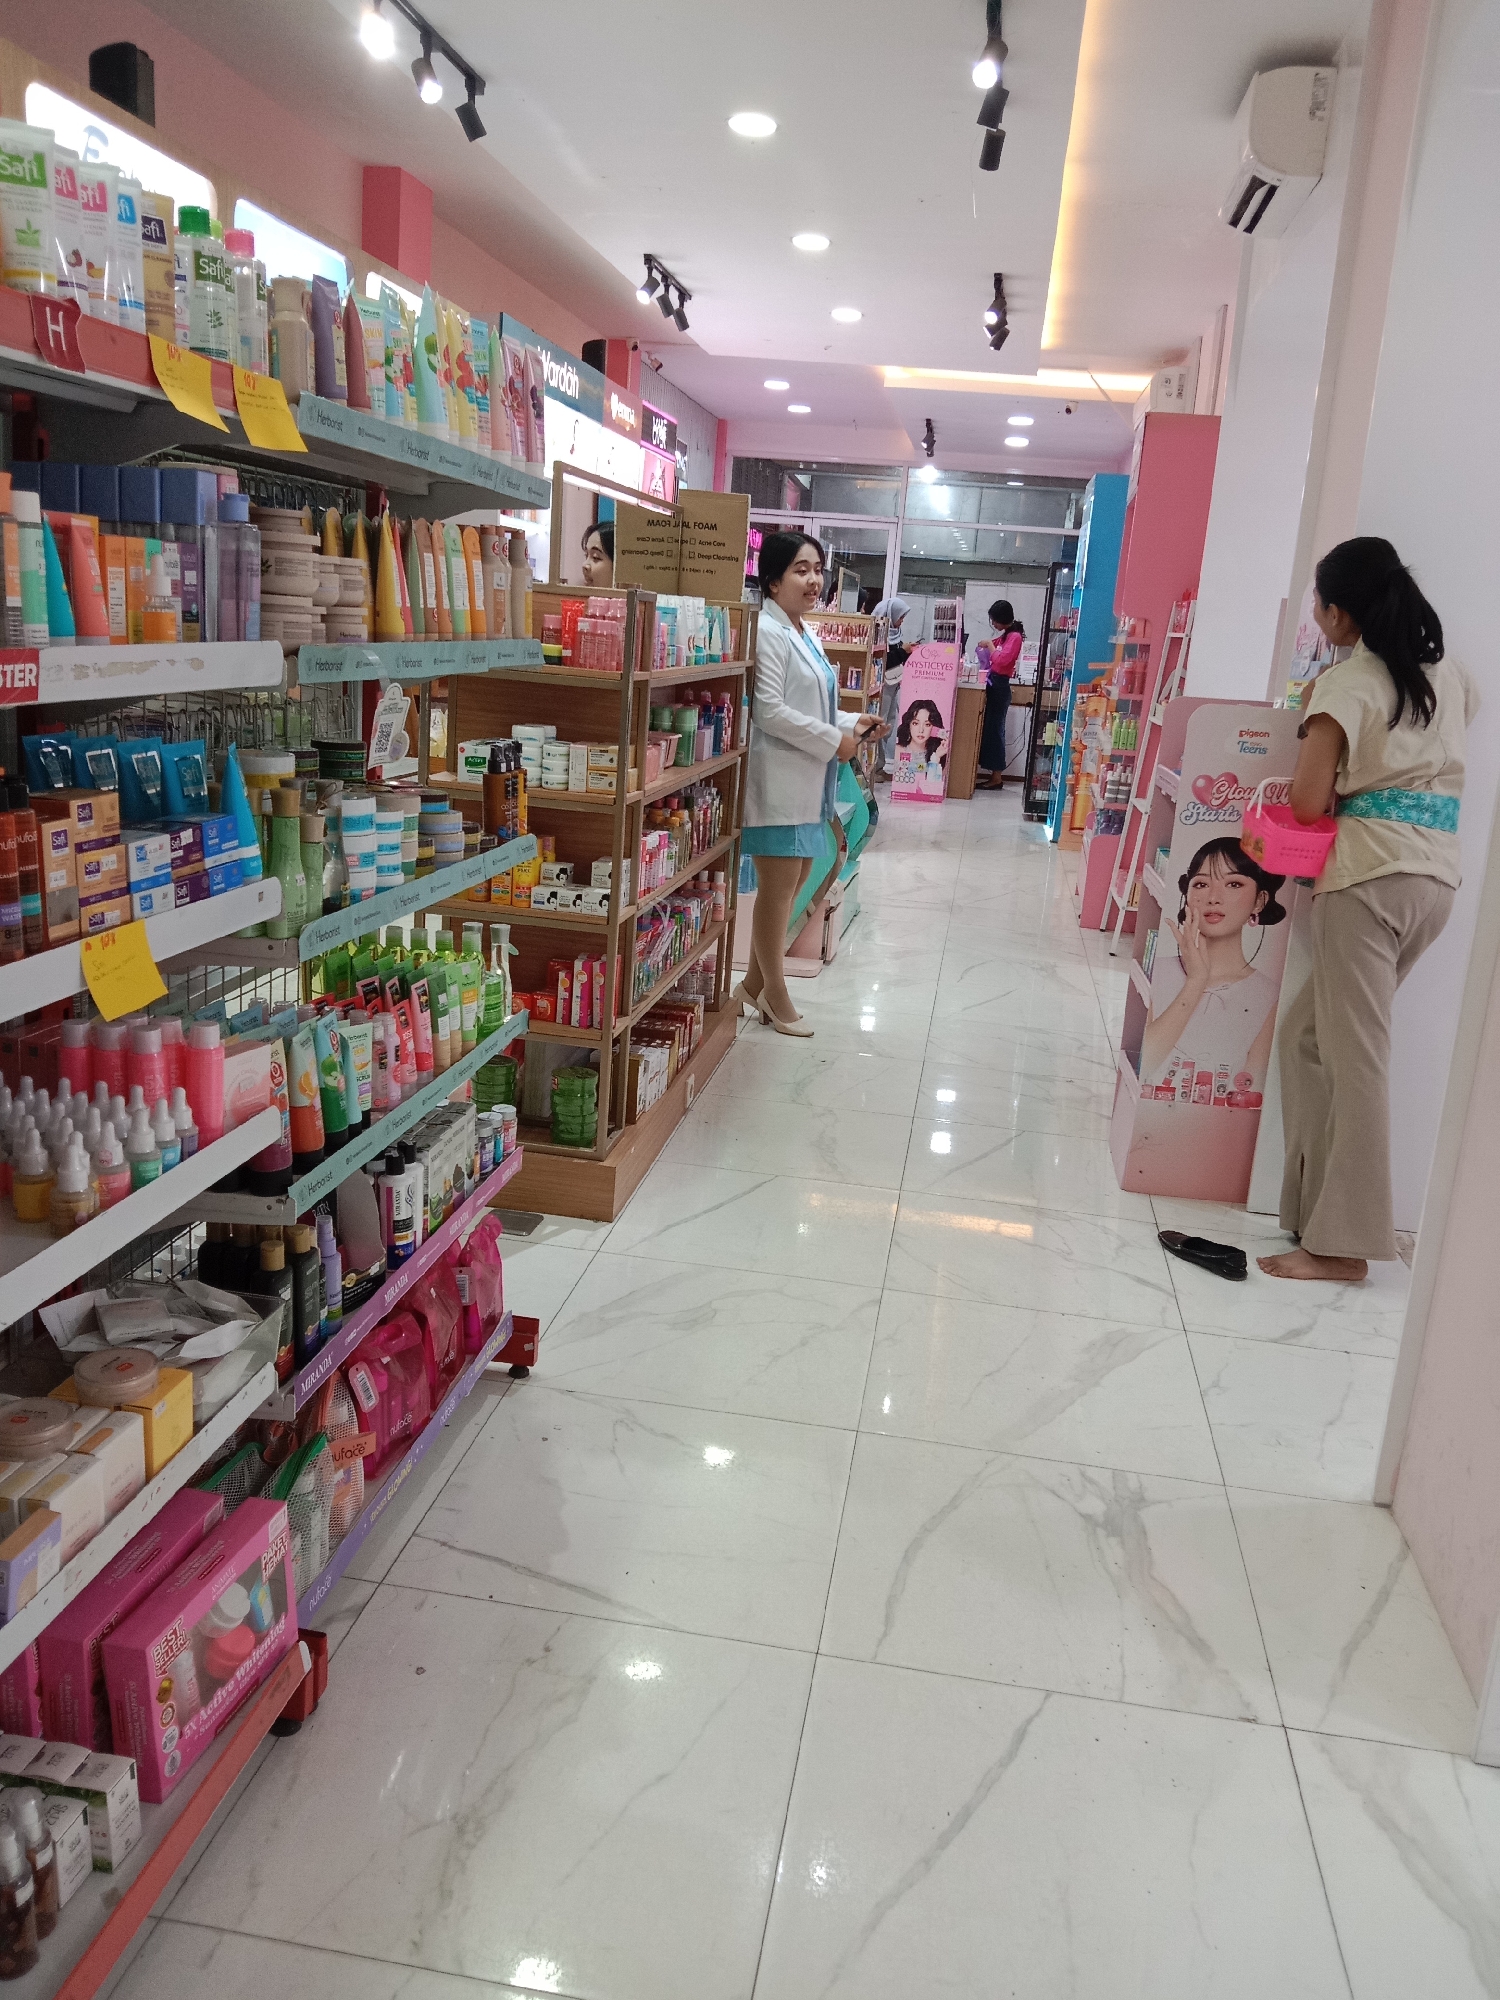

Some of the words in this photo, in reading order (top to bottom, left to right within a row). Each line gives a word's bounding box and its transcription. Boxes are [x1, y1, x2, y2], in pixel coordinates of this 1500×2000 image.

[0, 154, 41, 183] Safi
[55, 166, 73, 194] afi
[80, 185, 102, 208] afi
[199, 258, 225, 282] Safi
[317, 408, 343, 432] Herborist
[407, 441, 430, 462] Herborist
[693, 521, 718, 531] FOAM
[698, 539, 712, 547] Acne
[713, 540, 726, 548] Care
[697, 553, 711, 562] Deep
[712, 554, 739, 563] Cleansing
[315, 657, 343, 672] Herborist
[402, 658, 423, 669] Herborist
[471, 655, 487, 666] Herborist
[906, 660, 954, 671] MYSTICEYES
[1237, 740, 1268, 755] Teens
[78, 804, 92, 819] Safi
[1179, 801, 1243, 826] Starts
[53, 832, 68, 847] Safi
[466, 866, 483, 879] Herborist
[176, 884, 189, 898] Safi
[400, 890, 421, 906] Herborist
[315, 924, 341, 944] Herborist
[391, 1110, 413, 1132] Herborist
[308, 1170, 334, 1197] Herborist
[384, 1271, 409, 1307] MIRANDA
[300, 1353, 334, 1396] MIRANDA
[389, 1412, 413, 1436] nuface
[262, 1531, 288, 1570] PAKET
[262, 1543, 289, 1585] HEMAT
[153, 1616, 184, 1661] BEST
[155, 1628, 188, 1671] SELLER!
[199, 1677, 236, 1721] Active
[236, 1611, 286, 1678] Whitening
